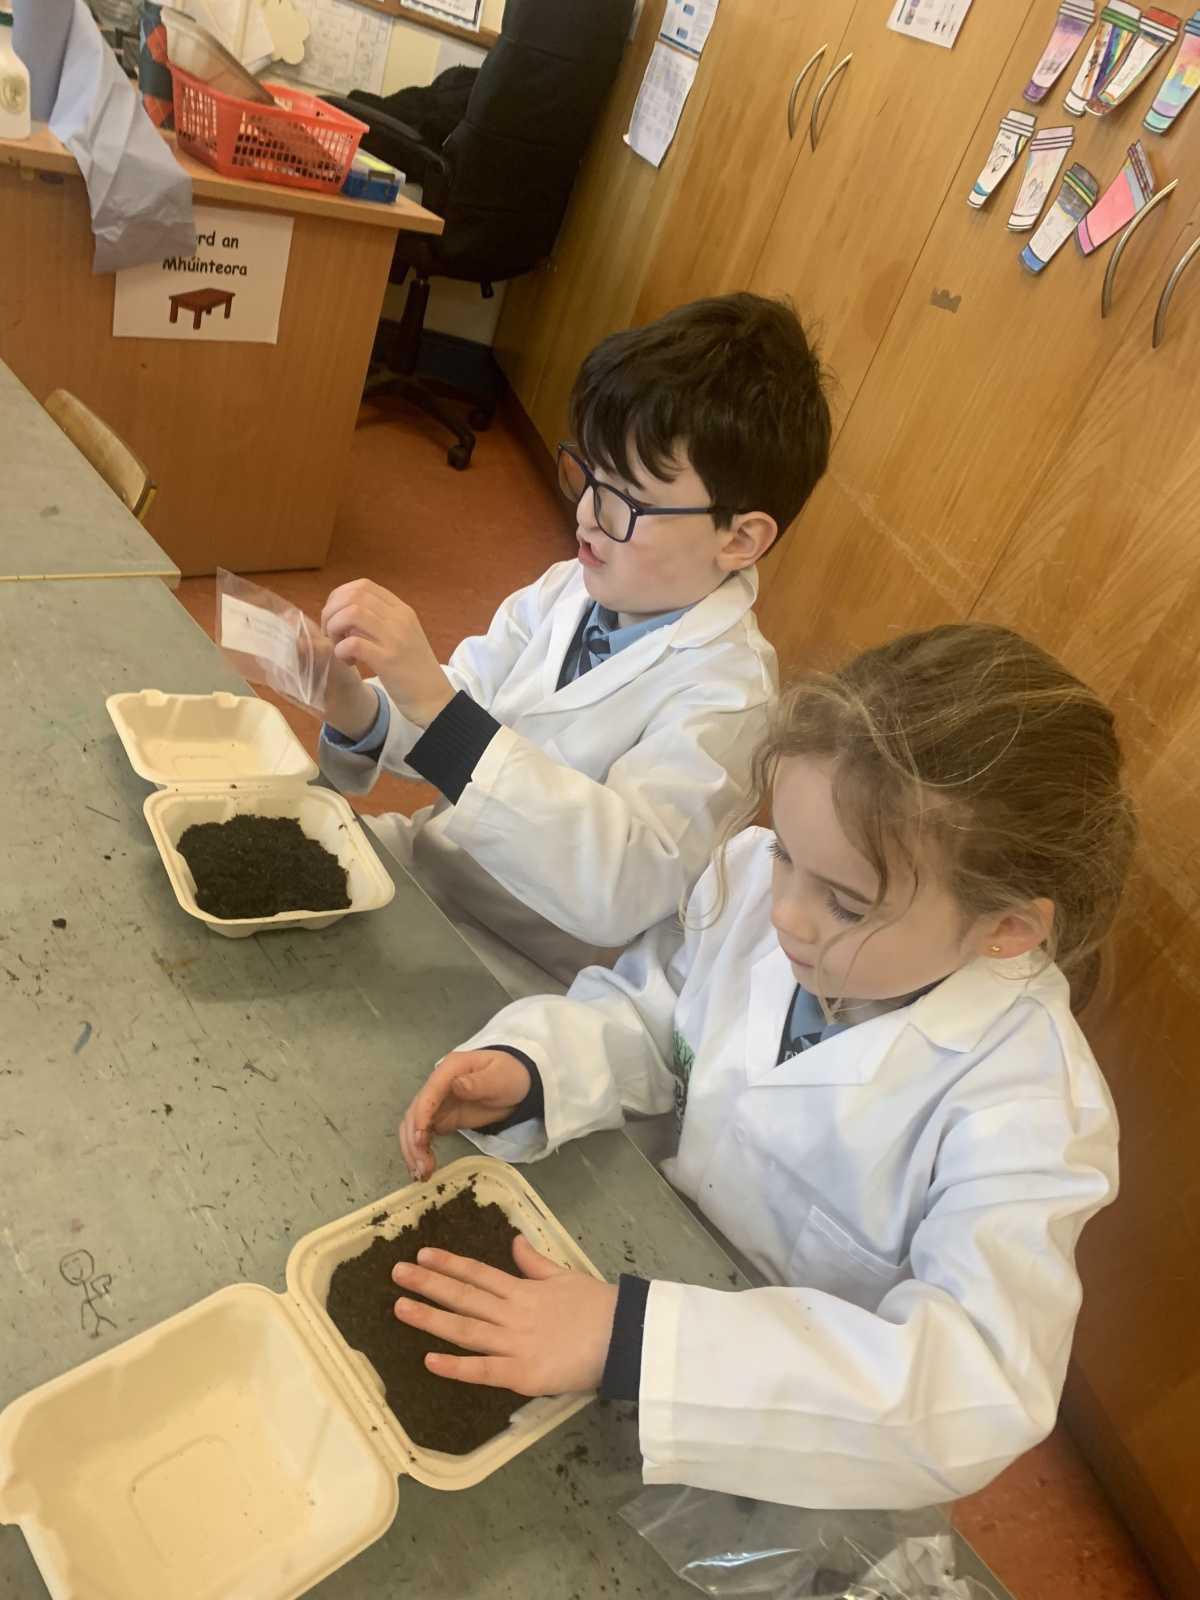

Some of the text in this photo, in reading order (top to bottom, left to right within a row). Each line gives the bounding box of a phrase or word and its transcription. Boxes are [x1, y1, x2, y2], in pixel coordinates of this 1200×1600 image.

[195, 230, 239, 249] rd an
[162, 255, 248, 276] Mhúinteora
